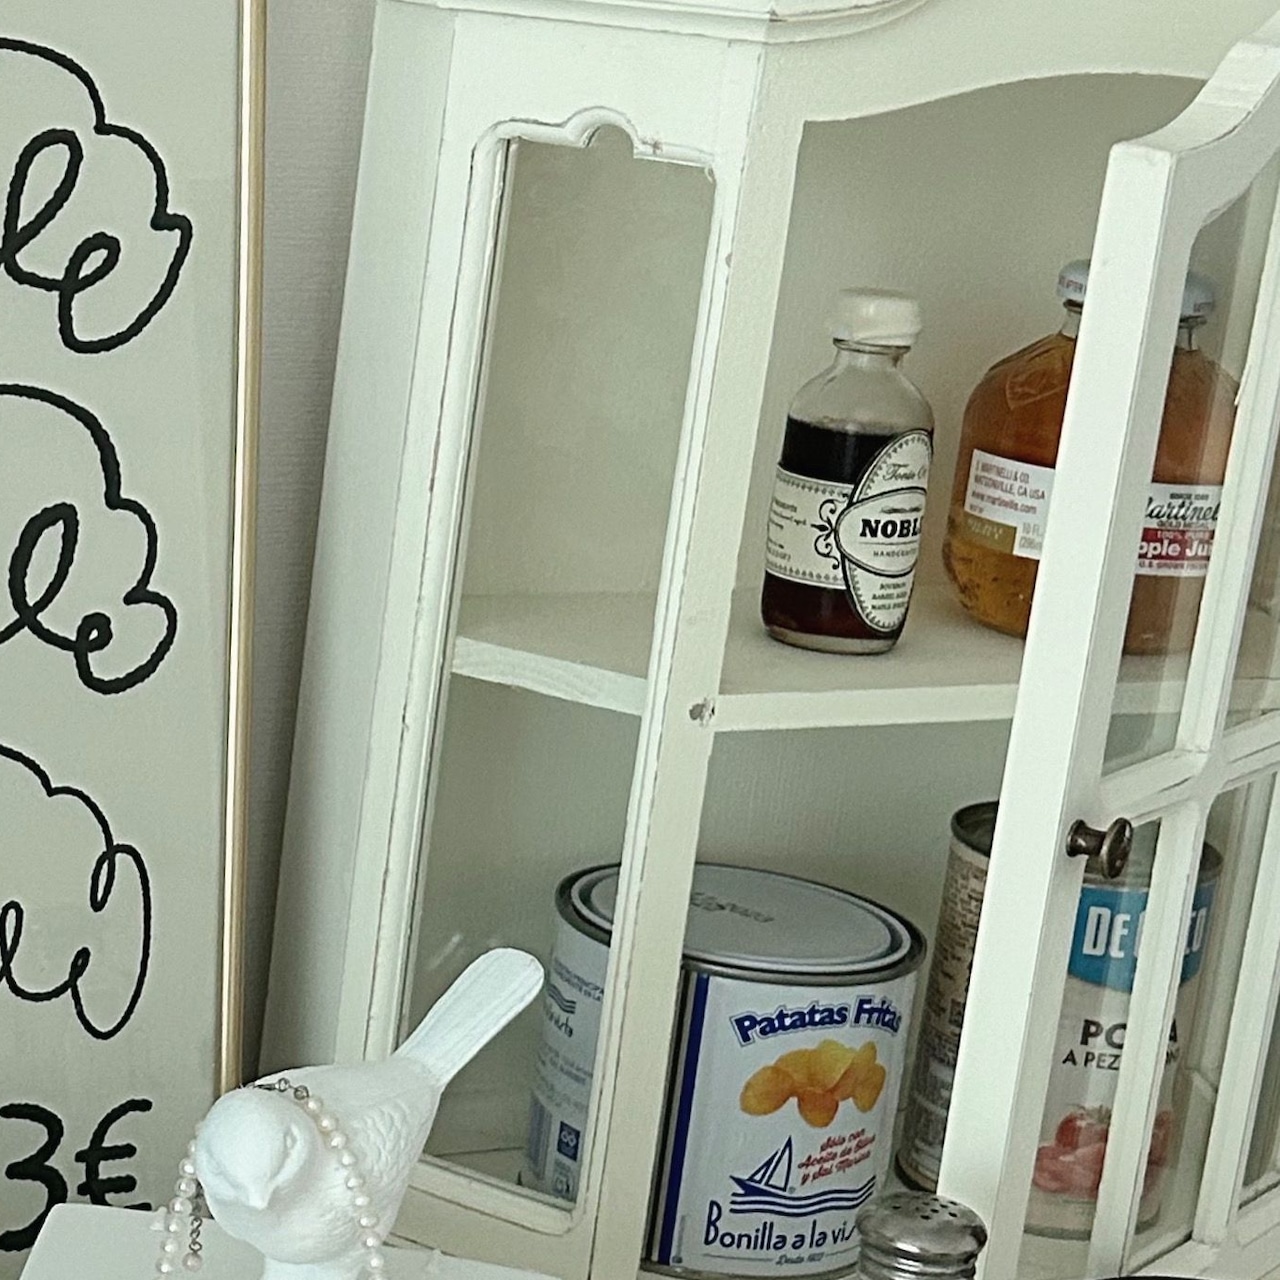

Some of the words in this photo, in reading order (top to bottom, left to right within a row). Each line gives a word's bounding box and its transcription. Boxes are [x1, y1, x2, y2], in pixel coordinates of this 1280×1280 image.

[733, 1004, 849, 1043] Patatas
[853, 997, 903, 1034] Fritas
[1062, 1049, 1078, 1067] A
[703, 1199, 788, 1251] Bonilla
[791, 1233, 806, 1250] a
[809, 1219, 828, 1249] la
